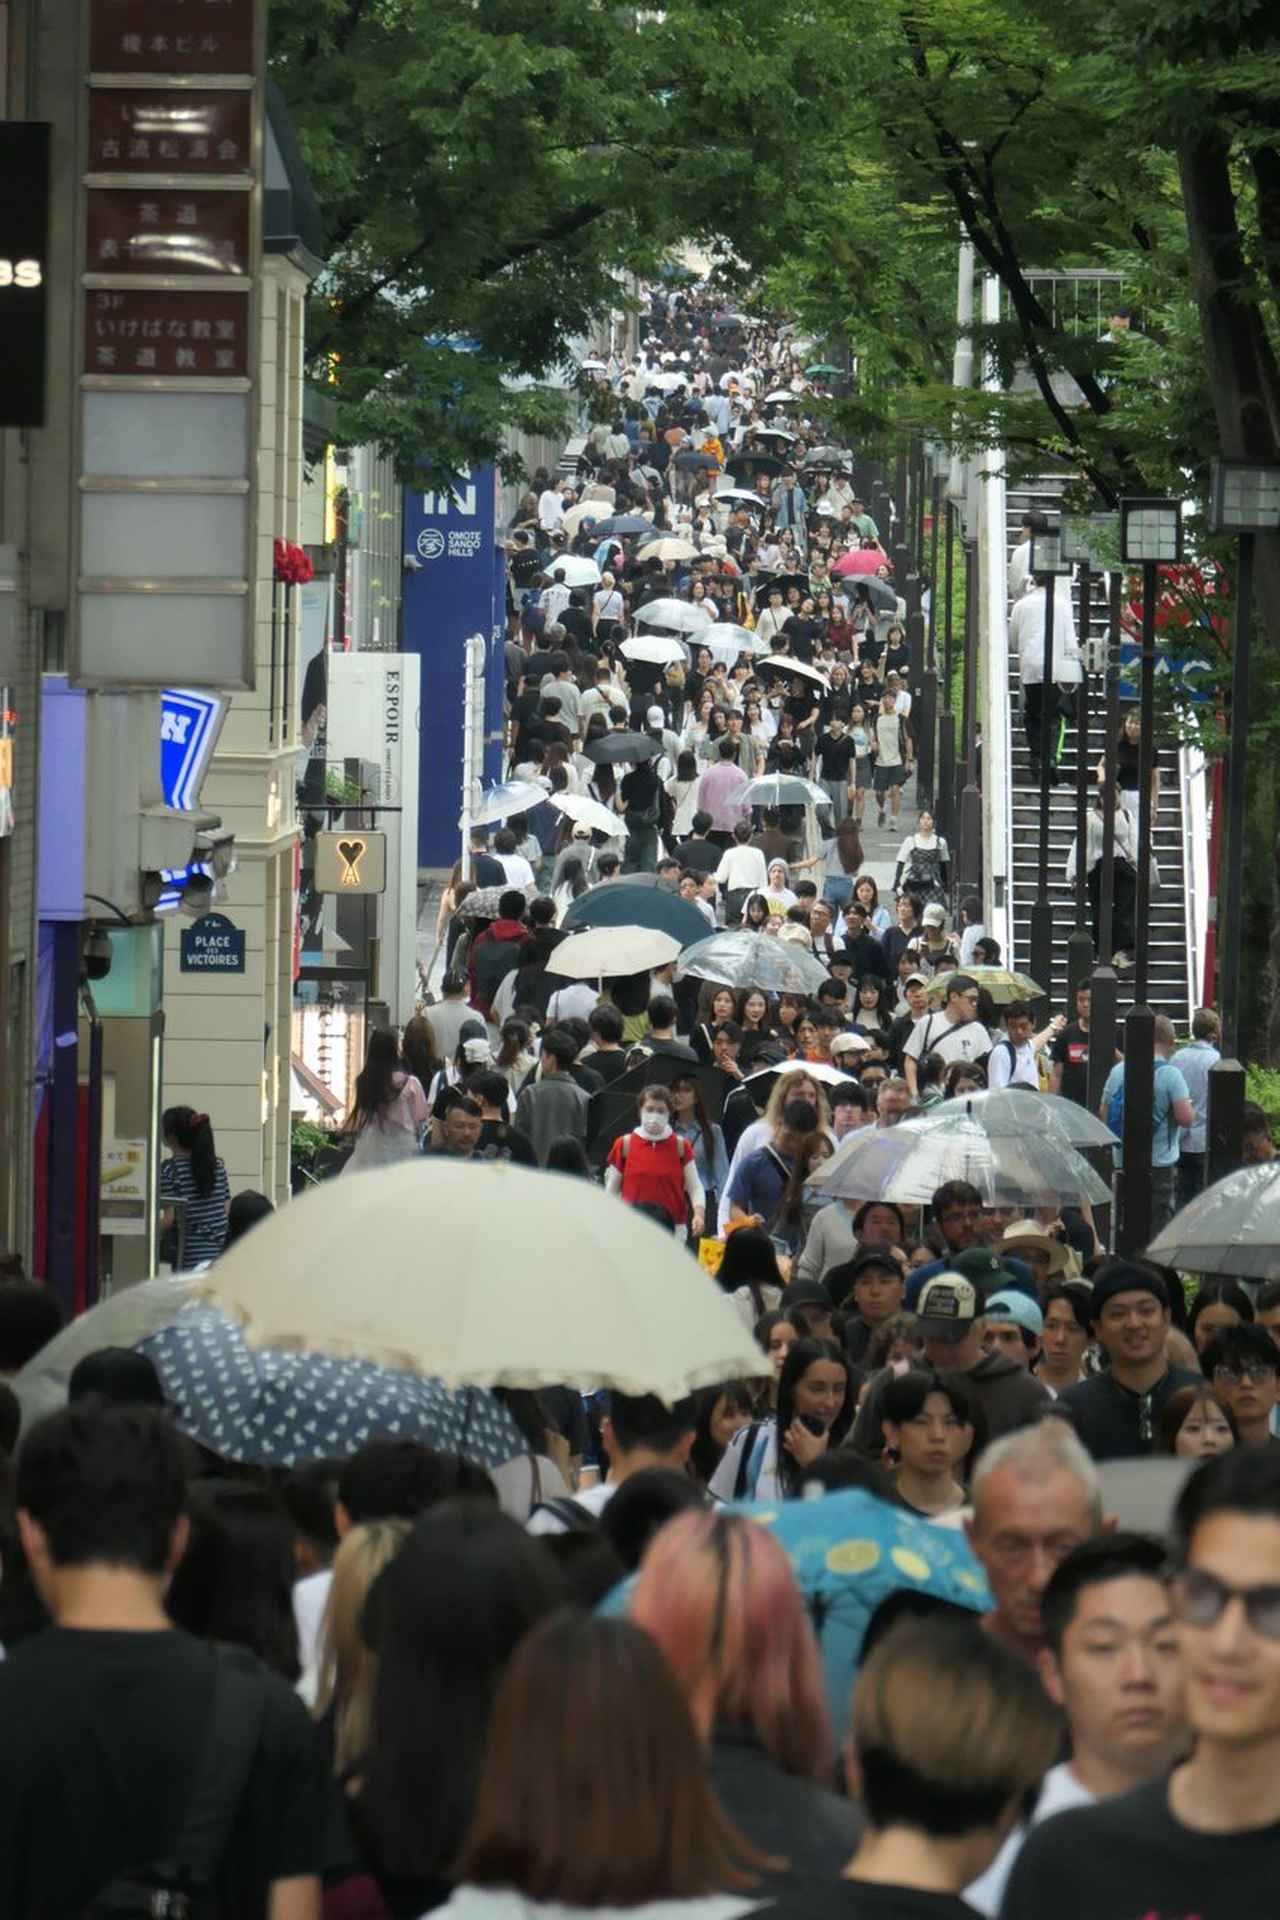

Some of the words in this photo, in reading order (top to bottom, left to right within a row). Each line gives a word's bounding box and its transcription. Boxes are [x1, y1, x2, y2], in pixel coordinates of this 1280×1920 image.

[96, 320, 234, 337] いけばな教室
[97, 346, 234, 367] 茶道教室
[447, 531, 481, 541] OMOTE
[447, 540, 480, 549] SANDO
[447, 548, 474, 557] HILLS
[385, 671, 400, 744] ESPOIR
[194, 936, 231, 948] PLACE
[186, 953, 239, 966] VICTOIRES
